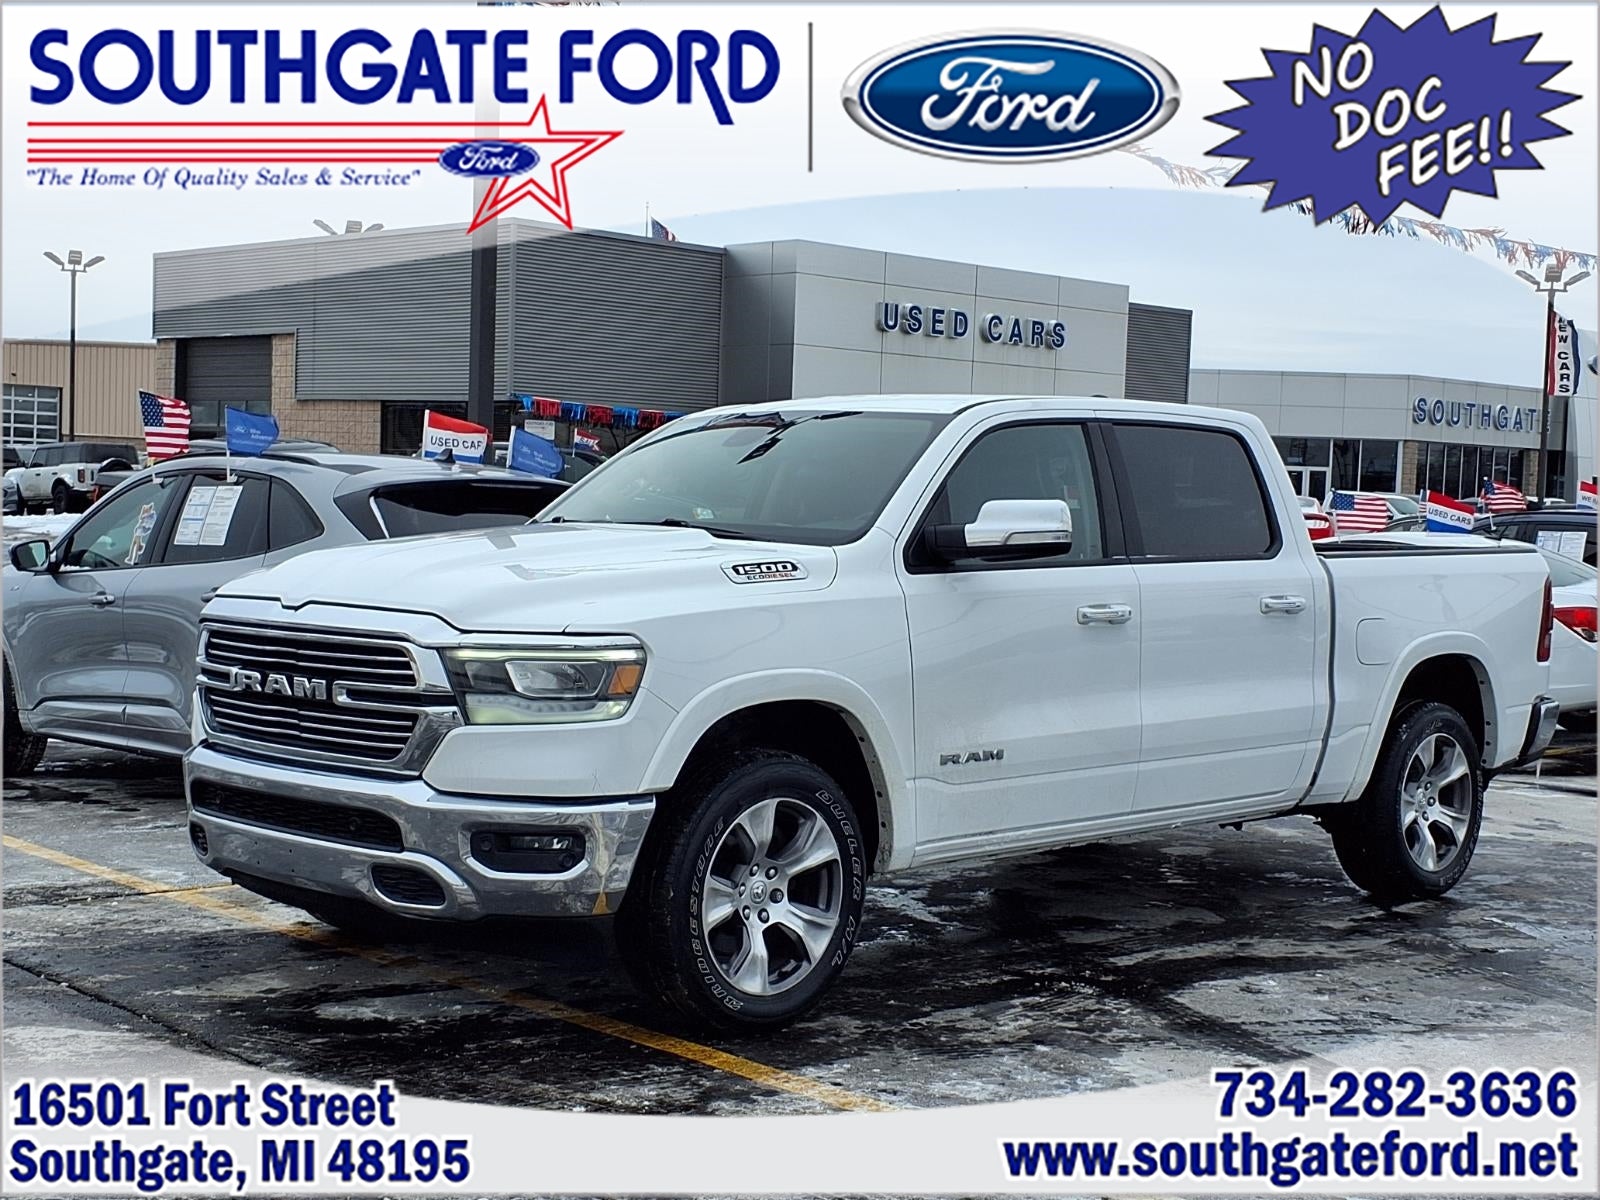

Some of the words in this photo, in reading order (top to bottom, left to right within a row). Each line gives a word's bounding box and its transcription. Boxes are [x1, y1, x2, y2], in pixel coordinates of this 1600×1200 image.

[877, 302, 969, 338] USED
[980, 313, 1067, 349] CARS
[1557, 351, 1571, 394] CARS
[1414, 397, 1550, 433] SOUTHGAT
[430, 435, 460, 449] USED
[1428, 507, 1449, 520] USED
[1450, 513, 1473, 527] CARS
[735, 562, 794, 575] 1500
[746, 572, 797, 581] ECODIESEL
[236, 668, 327, 700] RAM
[940, 749, 1005, 767] RAM
[814, 789, 862, 901] DUELER
[689, 815, 744, 1011] BRIDGESTONE
